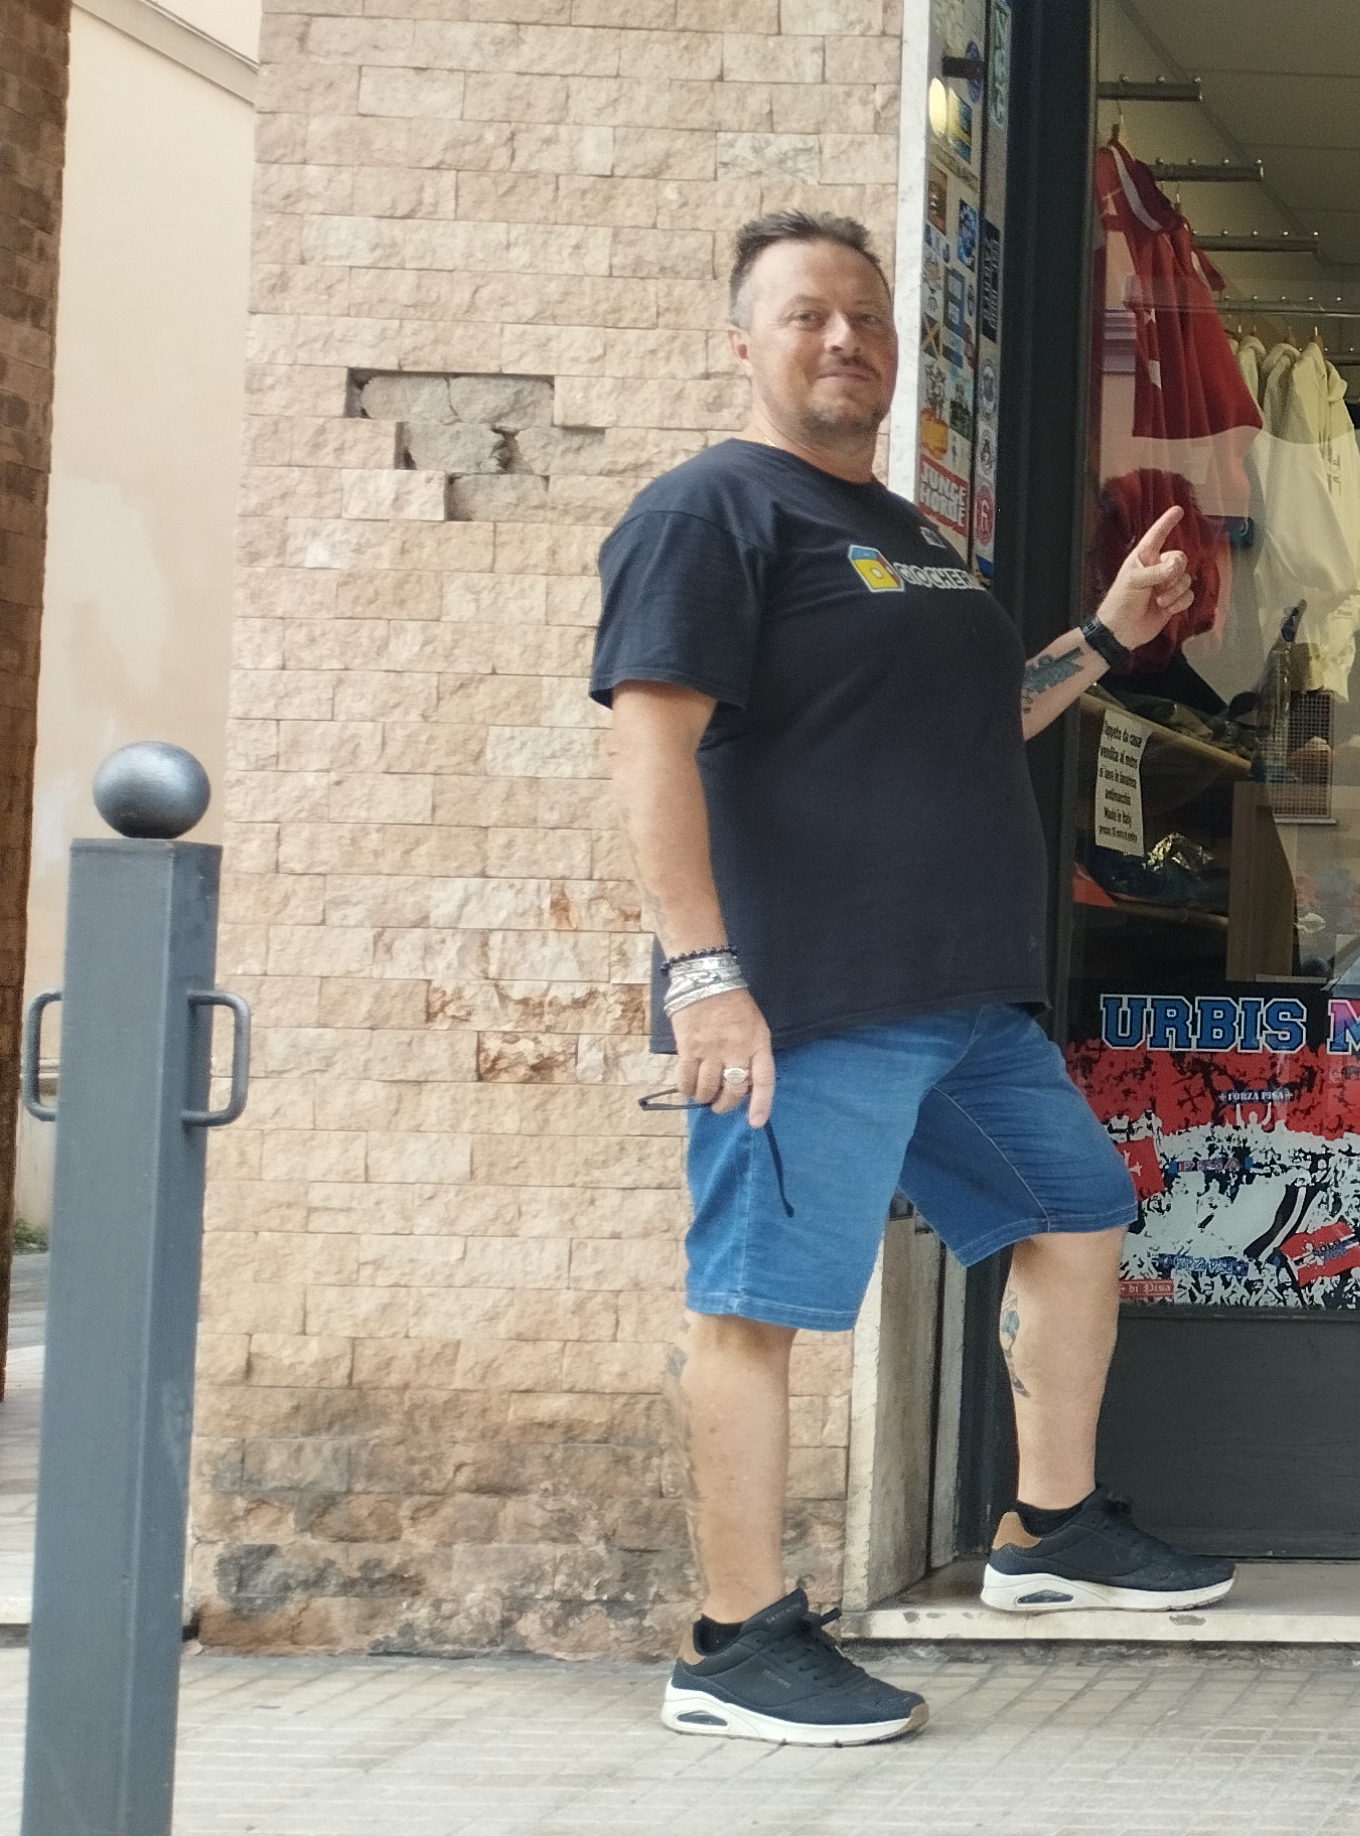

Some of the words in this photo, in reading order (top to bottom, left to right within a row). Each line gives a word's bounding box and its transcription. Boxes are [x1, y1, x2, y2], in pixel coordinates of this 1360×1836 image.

[1100, 994, 1307, 1052] URBIS
[1228, 1091, 1260, 1101] FORZA
[1143, 1281, 1171, 1296] Pisa
